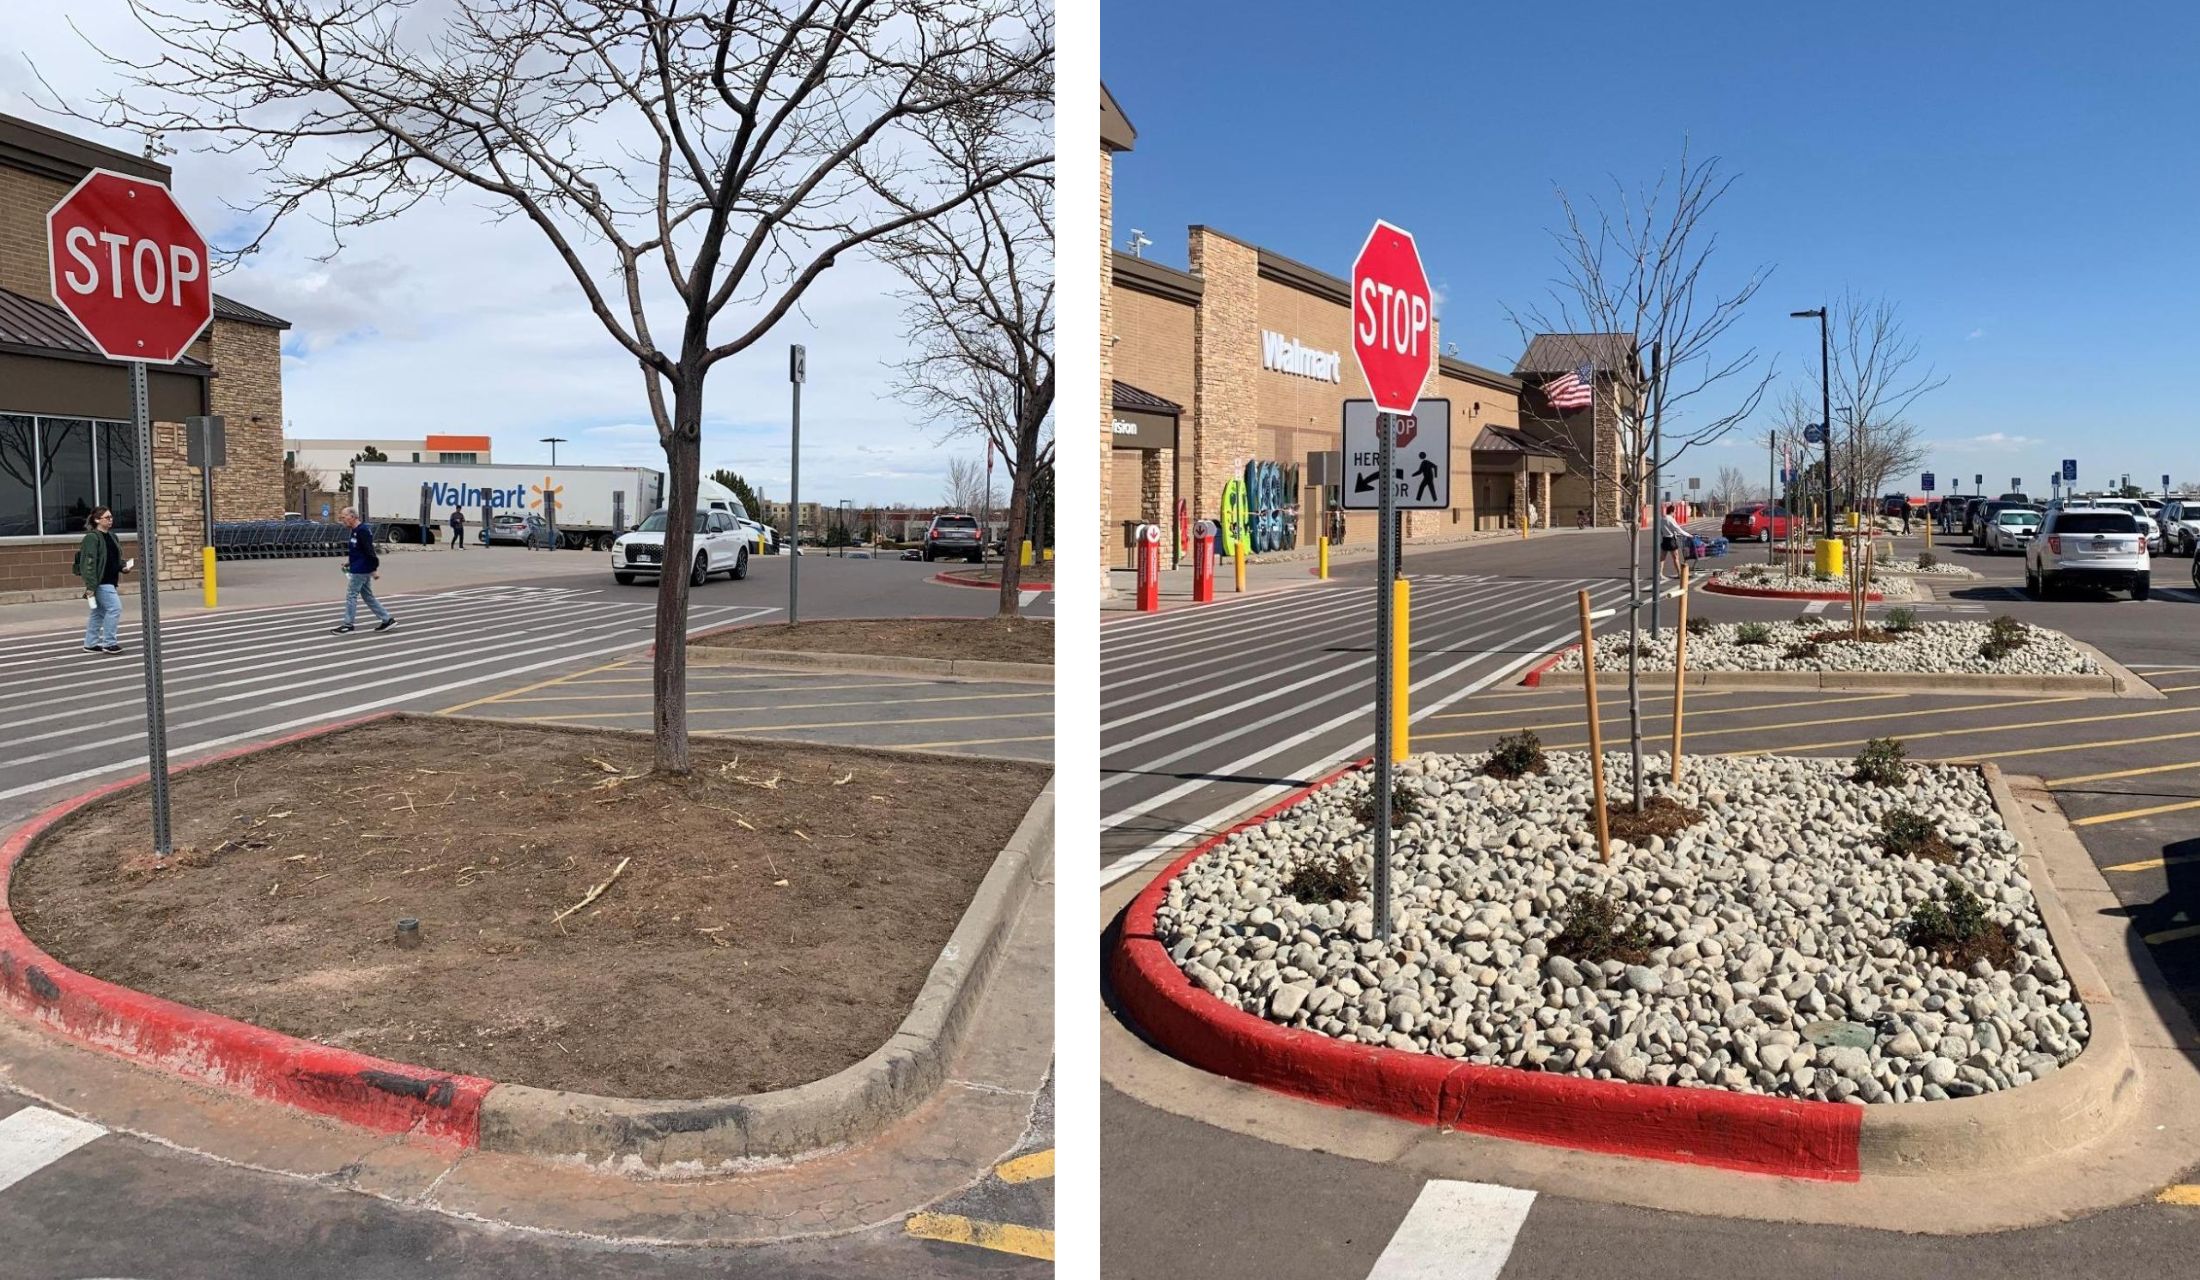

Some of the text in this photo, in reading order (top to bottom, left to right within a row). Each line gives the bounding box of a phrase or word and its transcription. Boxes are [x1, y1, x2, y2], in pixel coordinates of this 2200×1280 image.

[64, 226, 200, 307] STOP
[1359, 277, 1427, 357] STOP
[797, 358, 804, 378] 4
[1260, 328, 1340, 384] Walmart
[1354, 452, 1380, 466] HER
